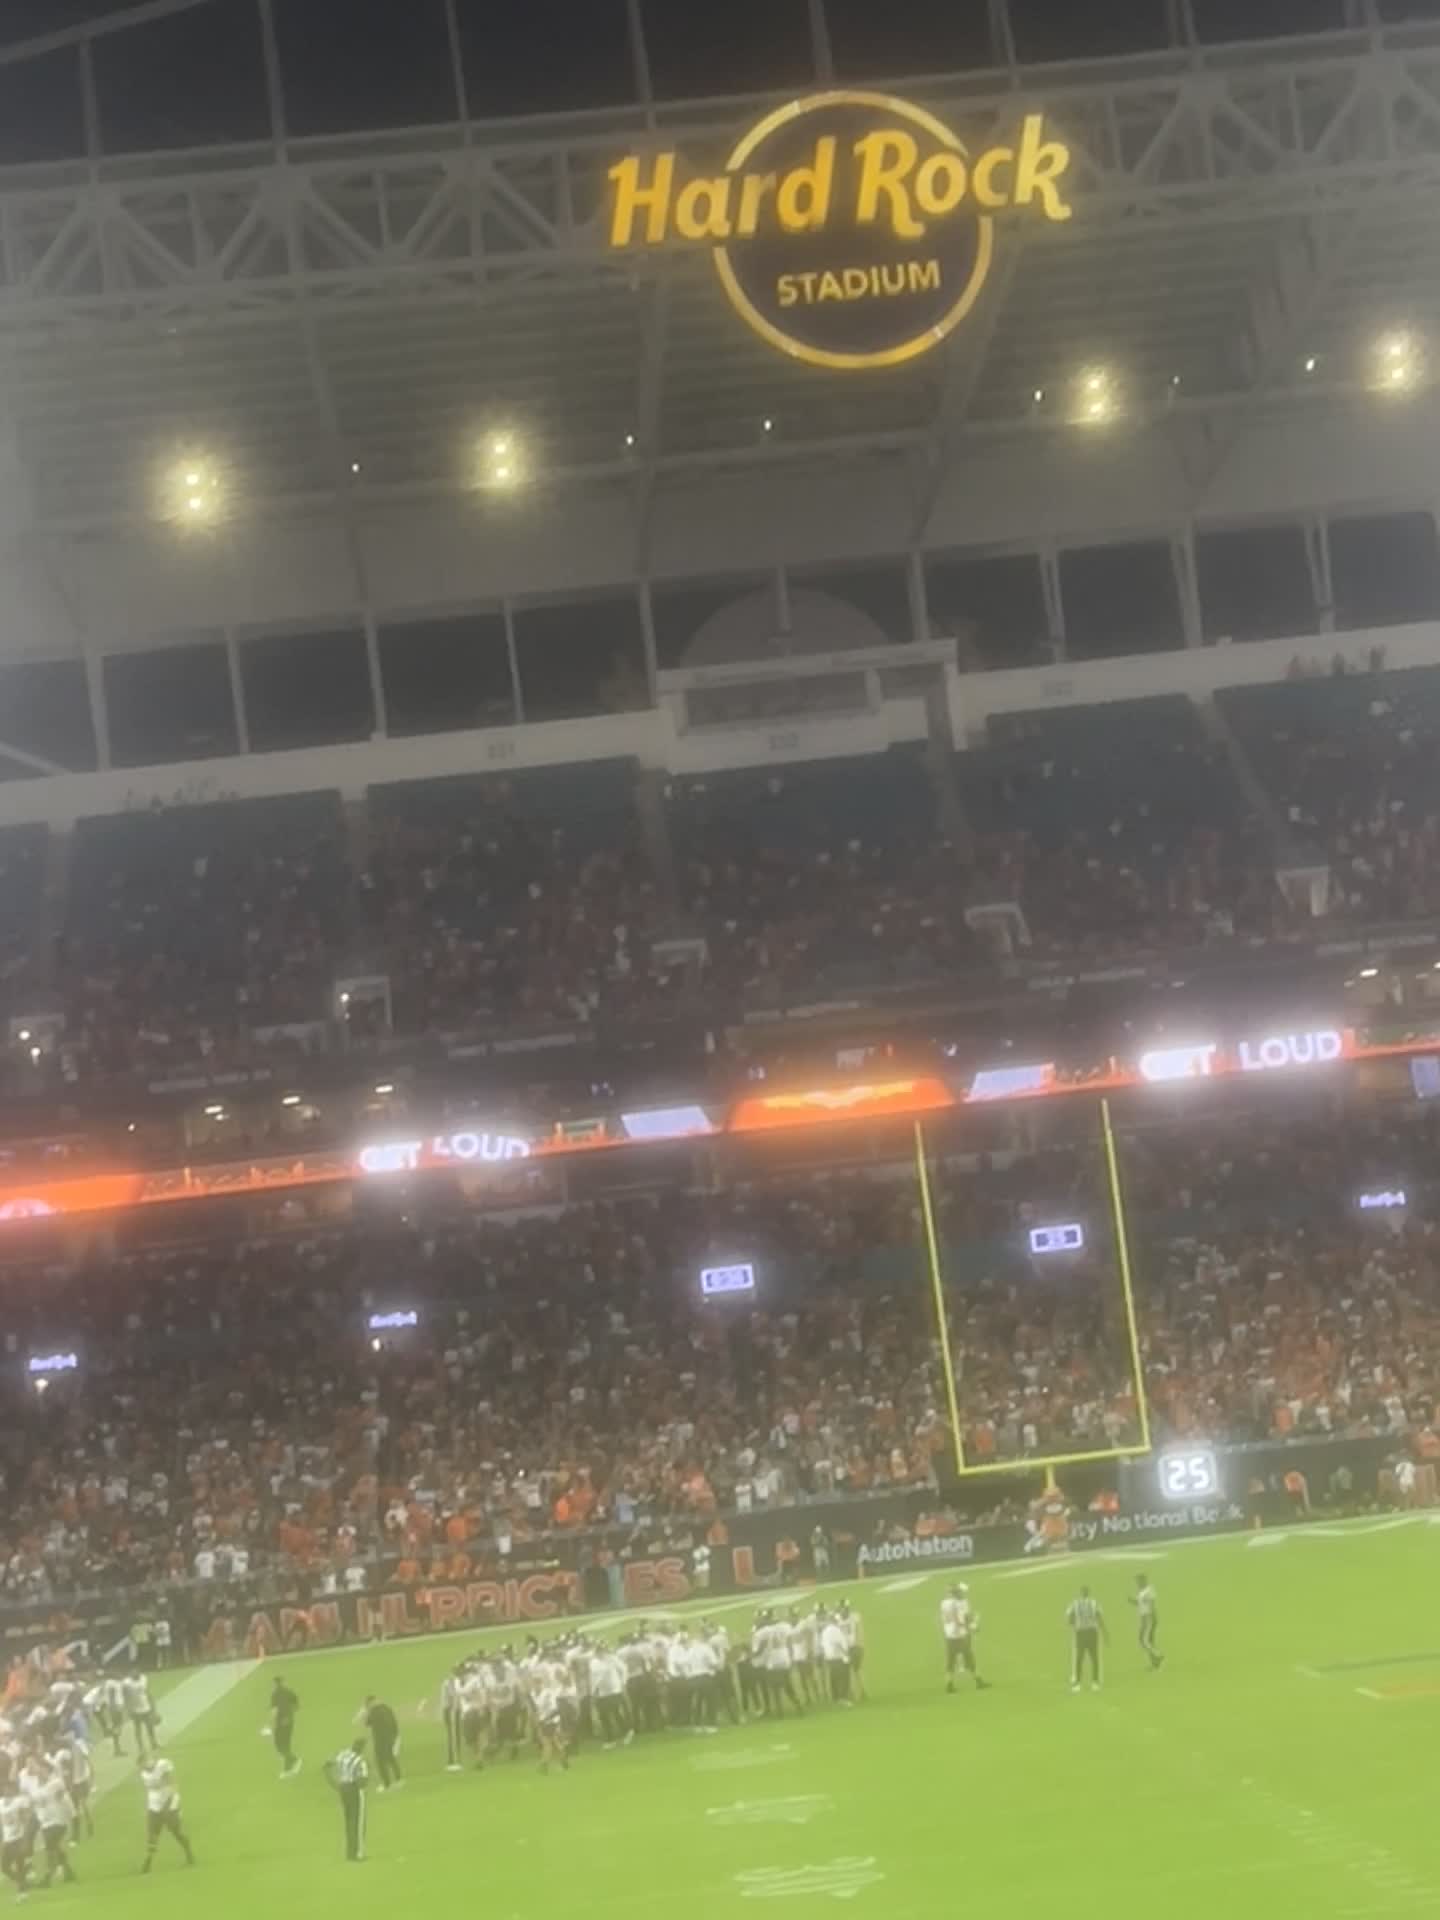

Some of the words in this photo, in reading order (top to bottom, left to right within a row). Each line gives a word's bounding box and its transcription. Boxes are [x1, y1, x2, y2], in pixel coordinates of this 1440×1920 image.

[607, 135, 837, 247] Hard
[853, 112, 1072, 238] Rock
[777, 259, 941, 306] STADIUM
[1239, 1030, 1343, 1071] LOUD
[1167, 1456, 1210, 1491] 25
[1103, 1507, 1189, 1533] National
[1192, 1502, 1245, 1526] Bak
[856, 1535, 974, 1564] AutoNation
